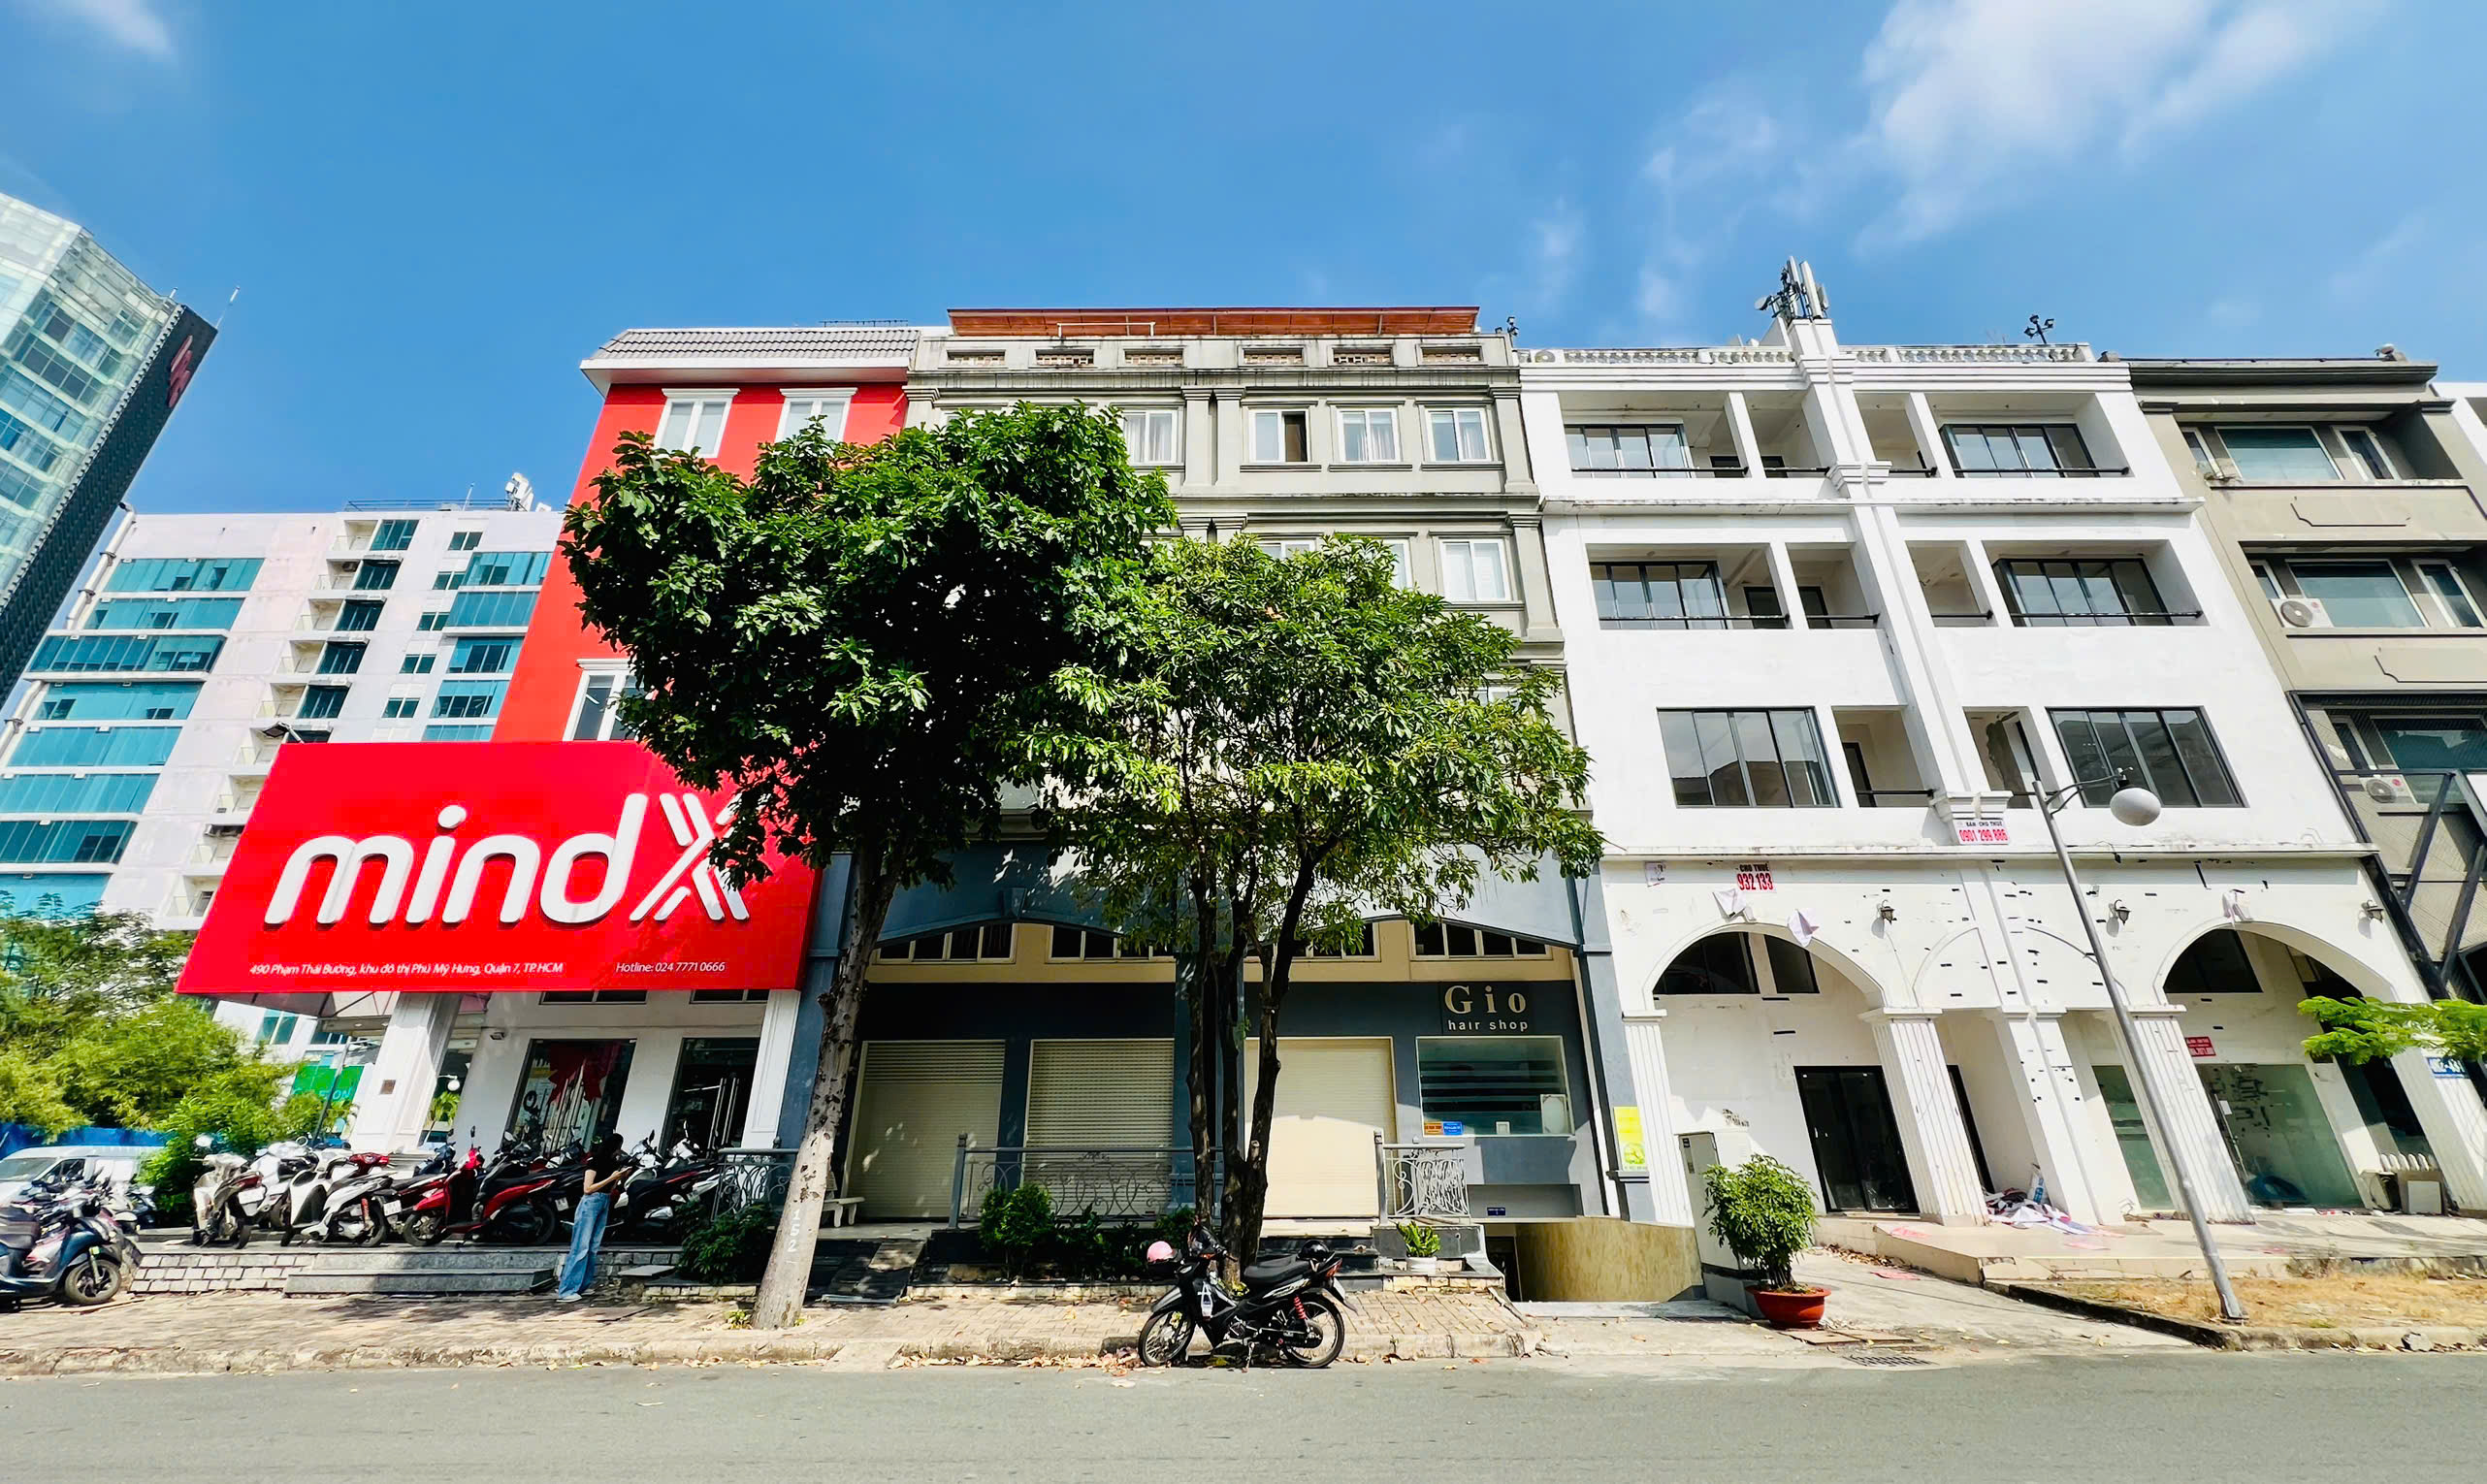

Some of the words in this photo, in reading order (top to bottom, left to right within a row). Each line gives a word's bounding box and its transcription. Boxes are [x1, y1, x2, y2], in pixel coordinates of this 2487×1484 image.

[264, 790, 749, 924] mindX
[1737, 873, 1756, 890] 932
[1756, 872, 1773, 890] 133
[249, 964, 271, 975] 490
[359, 962, 379, 975] khu
[615, 961, 654, 973] Hotline:
[655, 962, 674, 972] 024
[675, 961, 698, 972] 7771
[699, 961, 726, 972] 0666
[1444, 984, 1527, 1015] Gio
[1448, 1019, 1481, 1031] hair
[1489, 1019, 1529, 1032] shop
[787, 1209, 801, 1253] 152
